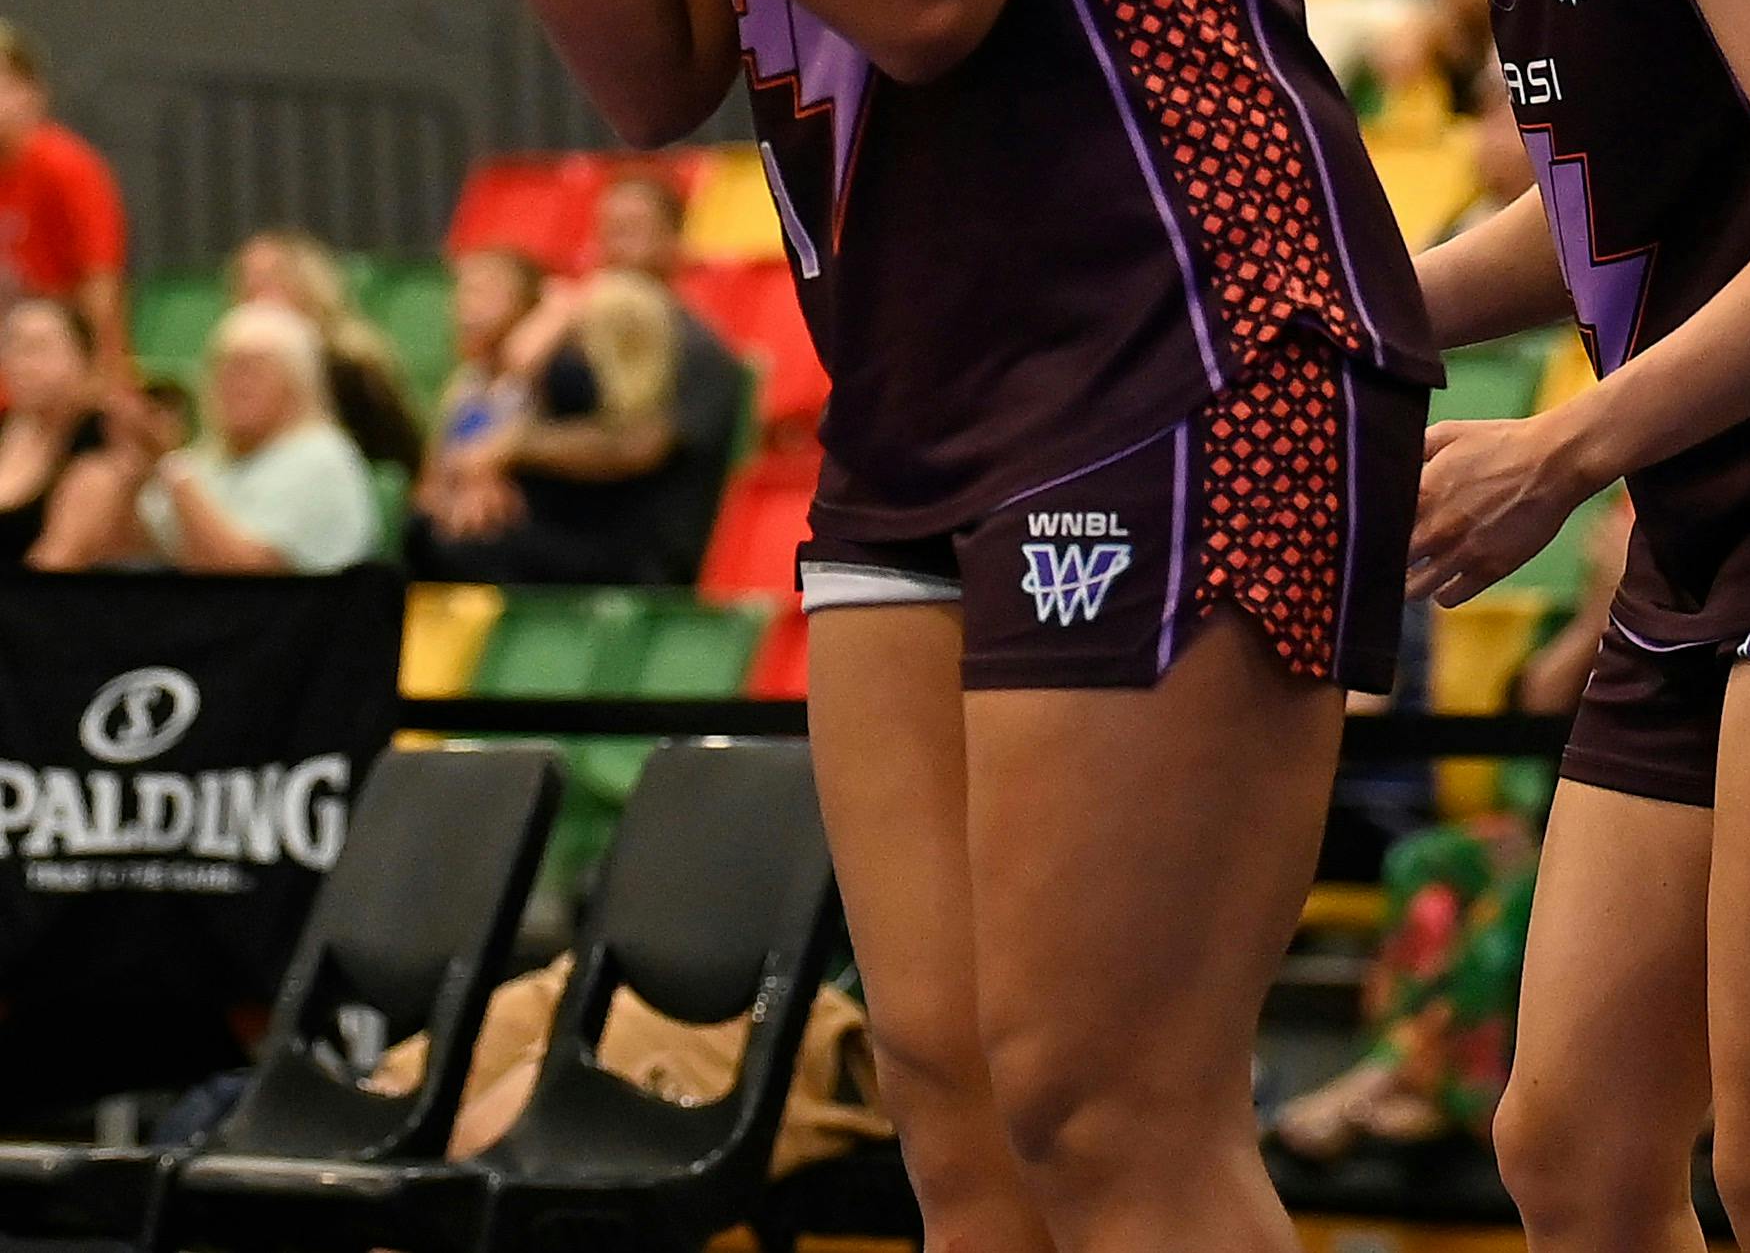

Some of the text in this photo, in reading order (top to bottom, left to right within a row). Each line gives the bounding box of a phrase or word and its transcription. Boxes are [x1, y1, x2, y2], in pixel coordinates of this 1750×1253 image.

[1503, 58, 1563, 105] ASI
[1027, 511, 1129, 537] WNBL
[0, 754, 351, 872] PALDING
